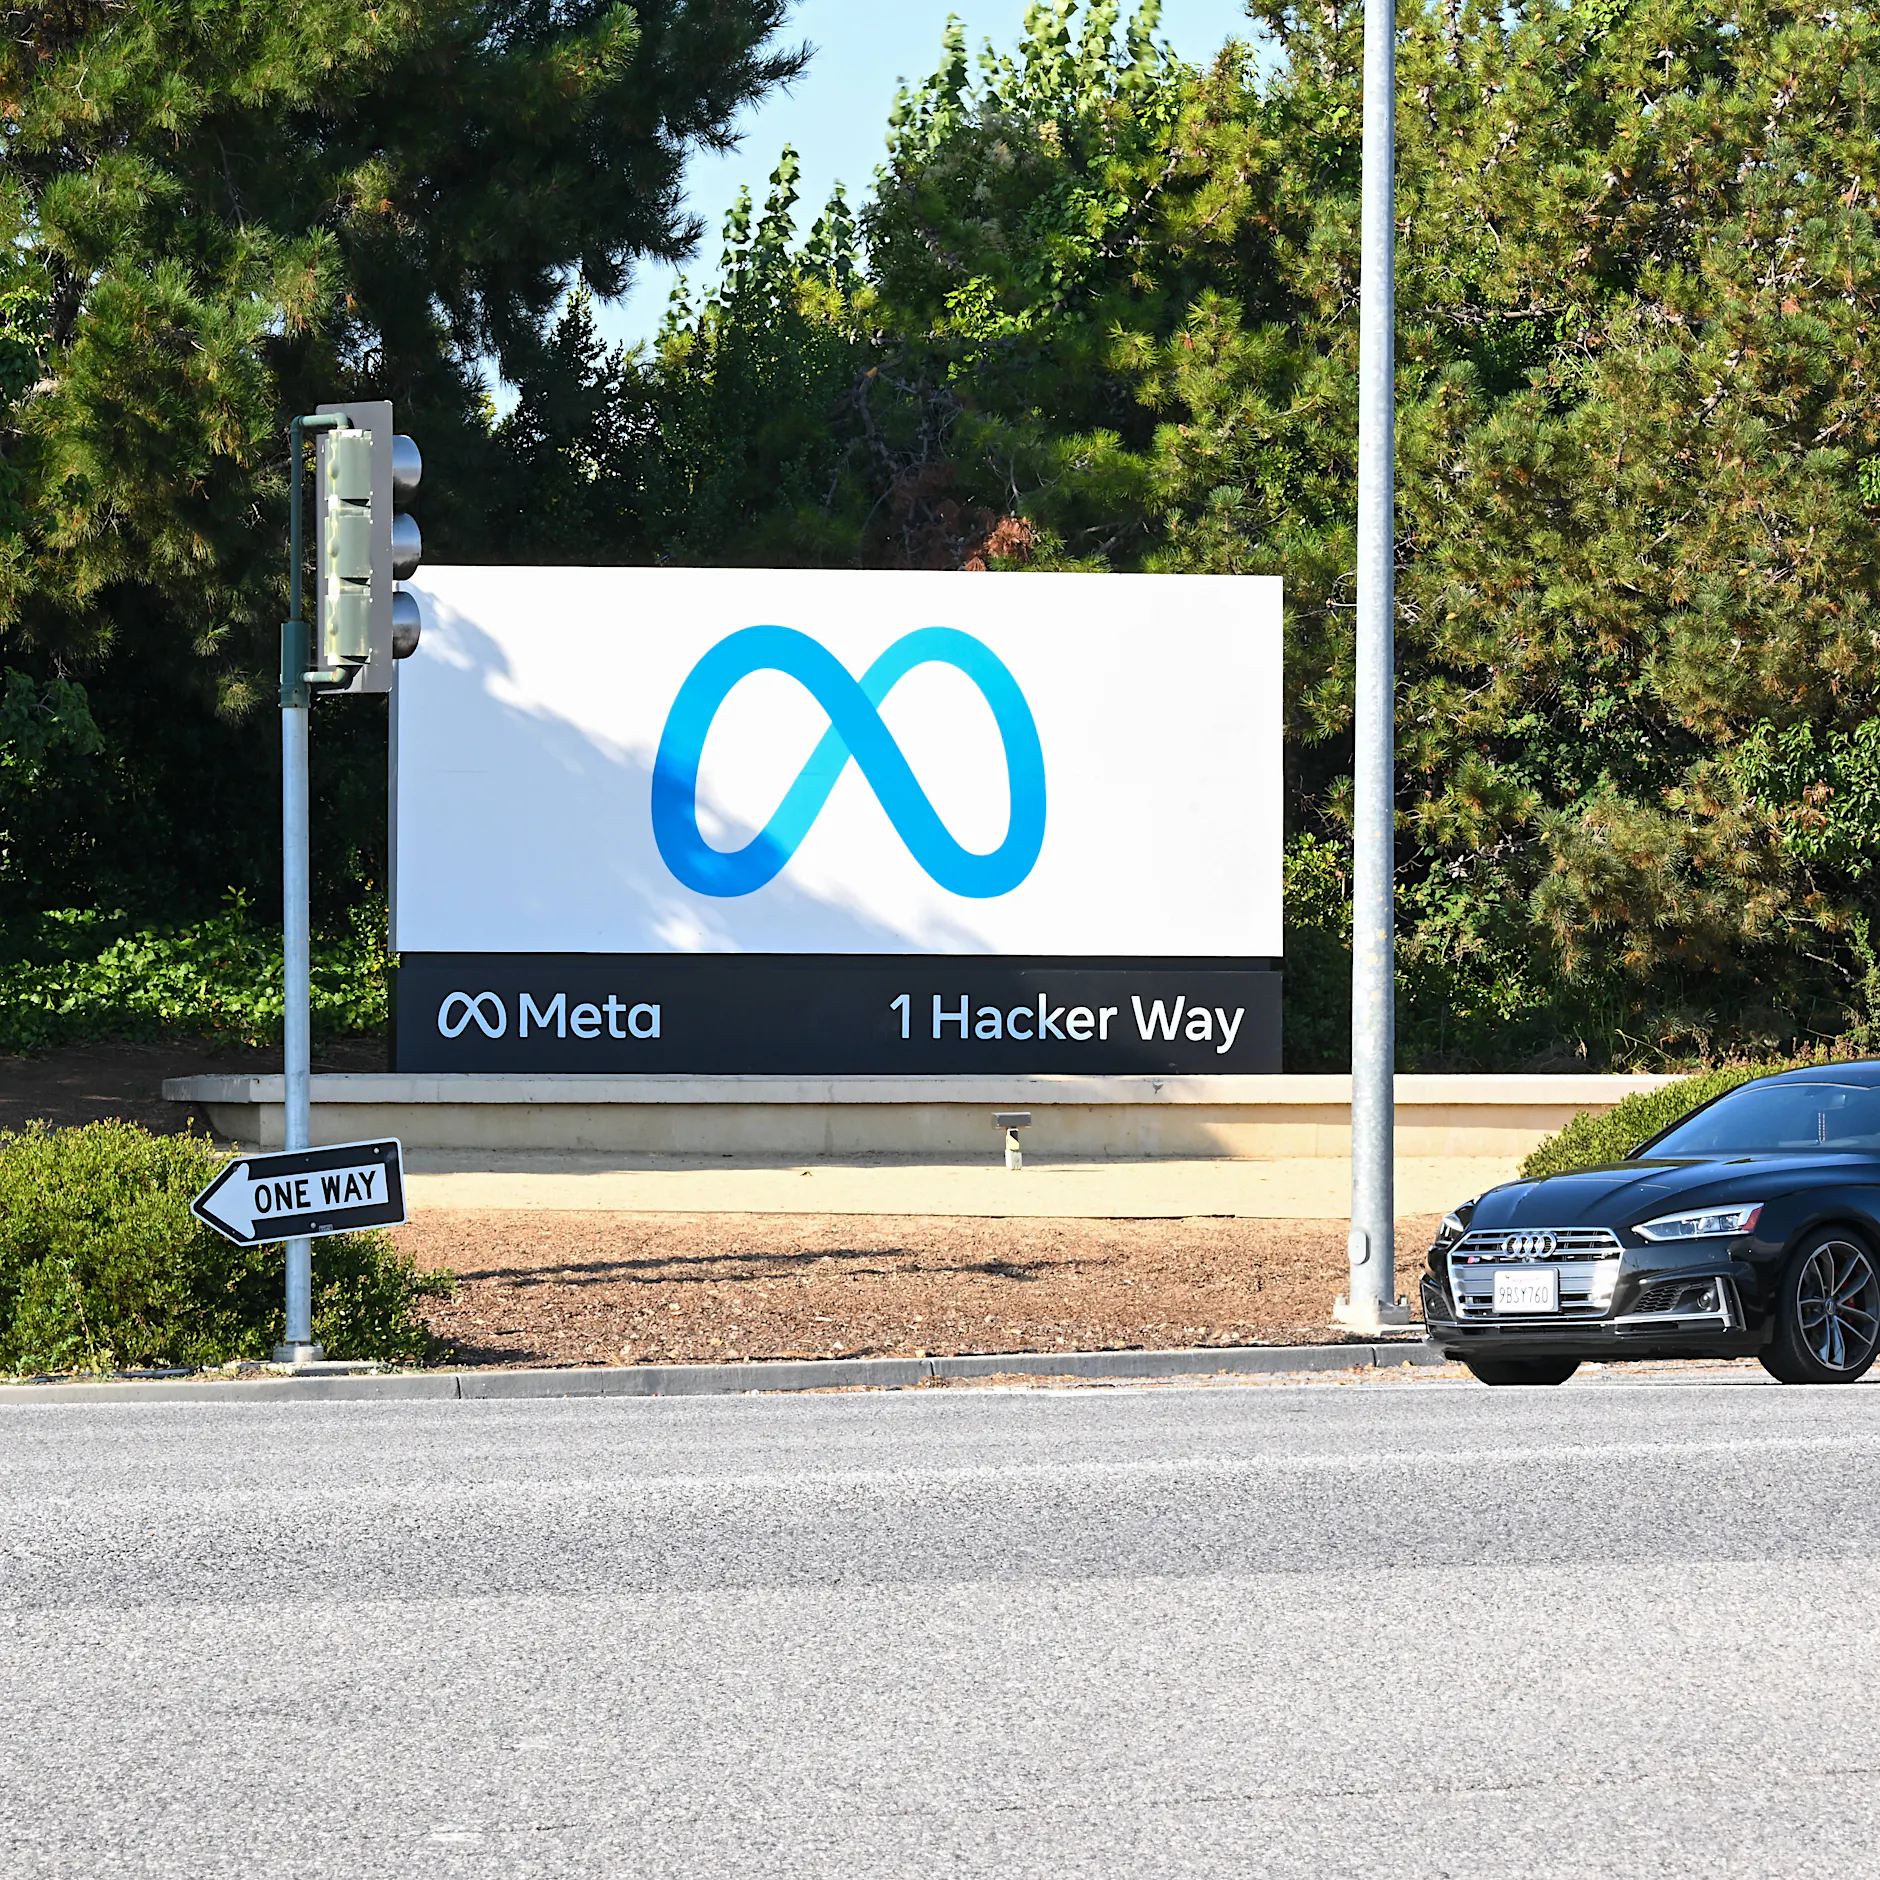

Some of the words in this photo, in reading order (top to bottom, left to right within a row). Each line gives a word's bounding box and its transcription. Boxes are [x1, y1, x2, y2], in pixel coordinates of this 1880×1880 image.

[519, 993, 661, 1039] Meta
[890, 993, 911, 1039] 1
[932, 993, 1118, 1041] Hacker
[1131, 995, 1245, 1054] Way
[254, 1179, 311, 1214] ONE
[321, 1170, 376, 1205] WAY
[1499, 1286, 1549, 1304] 9BSY760
